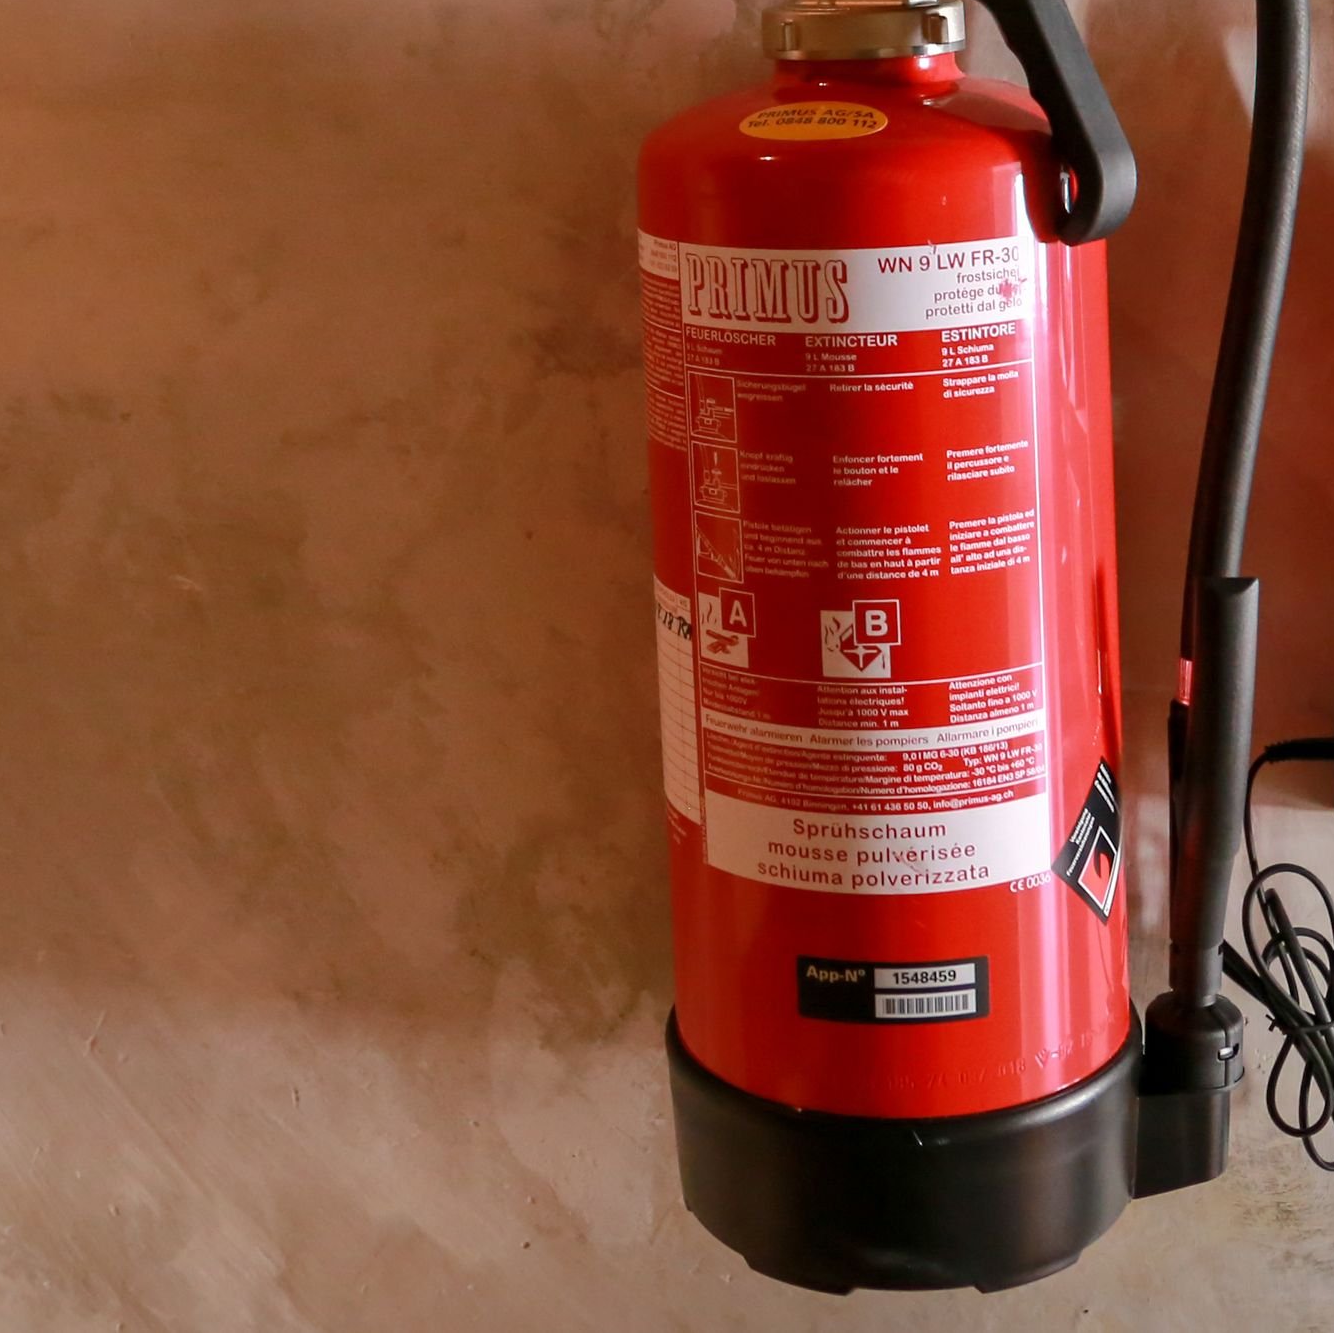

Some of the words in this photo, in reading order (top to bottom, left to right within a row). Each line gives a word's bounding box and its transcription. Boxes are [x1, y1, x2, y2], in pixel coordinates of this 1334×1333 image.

[758, 108, 817, 119] PRIMUS
[823, 109, 875, 119] AG/SA
[817, 117, 846, 126] 800
[852, 119, 877, 129] 112
[878, 257, 912, 274] WN
[919, 255, 930, 271] 9
[937, 252, 966, 270] LW
[971, 245, 1019, 267] FR-30
[686, 252, 850, 324] PRIMUS
[925, 303, 974, 320] protetti
[977, 300, 996, 313] dal
[941, 322, 1016, 343] ESTINTORE
[805, 334, 898, 348] EXTINCTEUR
[957, 343, 994, 355] Schiuma
[821, 353, 857, 361] Mousse
[942, 358, 952, 368] 27
[830, 383, 862, 392] Retirer
[942, 374, 987, 388] Strappare
[943, 389, 953, 399] di
[954, 385, 995, 398] sicurezza
[946, 447, 984, 459] Premere
[985, 440, 1029, 455] fortemente
[832, 455, 875, 464] Enfoncer
[877, 453, 924, 463] fortement
[954, 457, 1002, 472] percussore
[843, 466, 877, 475] bouton
[947, 469, 988, 482] rilasciare
[835, 525, 881, 535] Actionner
[894, 524, 929, 536] pistolet
[949, 518, 987, 530] Premere
[949, 529, 982, 541] iniziare
[990, 521, 1035, 536] combattere
[847, 537, 903, 546] commencer
[960, 540, 992, 552] fiamme
[993, 537, 1007, 547] dal
[1007, 532, 1031, 544] basso
[902, 546, 942, 556] flammes
[965, 552, 982, 562] alto
[884, 558, 905, 568] haut
[914, 557, 942, 569] partir
[951, 564, 975, 575] tanza
[976, 559, 1006, 571] iniziale
[866, 570, 906, 580] distance
[908, 569, 920, 578] de
[729, 599, 748, 628] A
[865, 609, 889, 637] B
[949, 676, 994, 691] Attenzione
[949, 689, 984, 702] impianti
[949, 700, 986, 713] Soltanto
[987, 697, 1003, 708] fino
[856, 708, 879, 717] 1000
[889, 708, 909, 716] max
[949, 712, 989, 724] Distanza
[990, 706, 1019, 718] almeno
[706, 714, 747, 735] Feuerwehr
[749, 725, 803, 743] alarmieren
[809, 735, 855, 746] Alarmer
[856, 735, 874, 747] les
[875, 735, 929, 748] pompiers
[936, 729, 989, 743] Allarmare
[923, 751, 938, 760] MG
[983, 754, 999, 764] WN
[913, 771, 970, 783] temperatura:
[932, 789, 1014, 809] info@primus-ag.ch
[793, 818, 947, 841] Sprühschaum
[768, 840, 848, 862] mousse
[857, 842, 976, 866] pulvérisée
[758, 862, 843, 885] schiuma
[851, 865, 989, 889] polverizzata
[892, 969, 957, 985] 1548459
